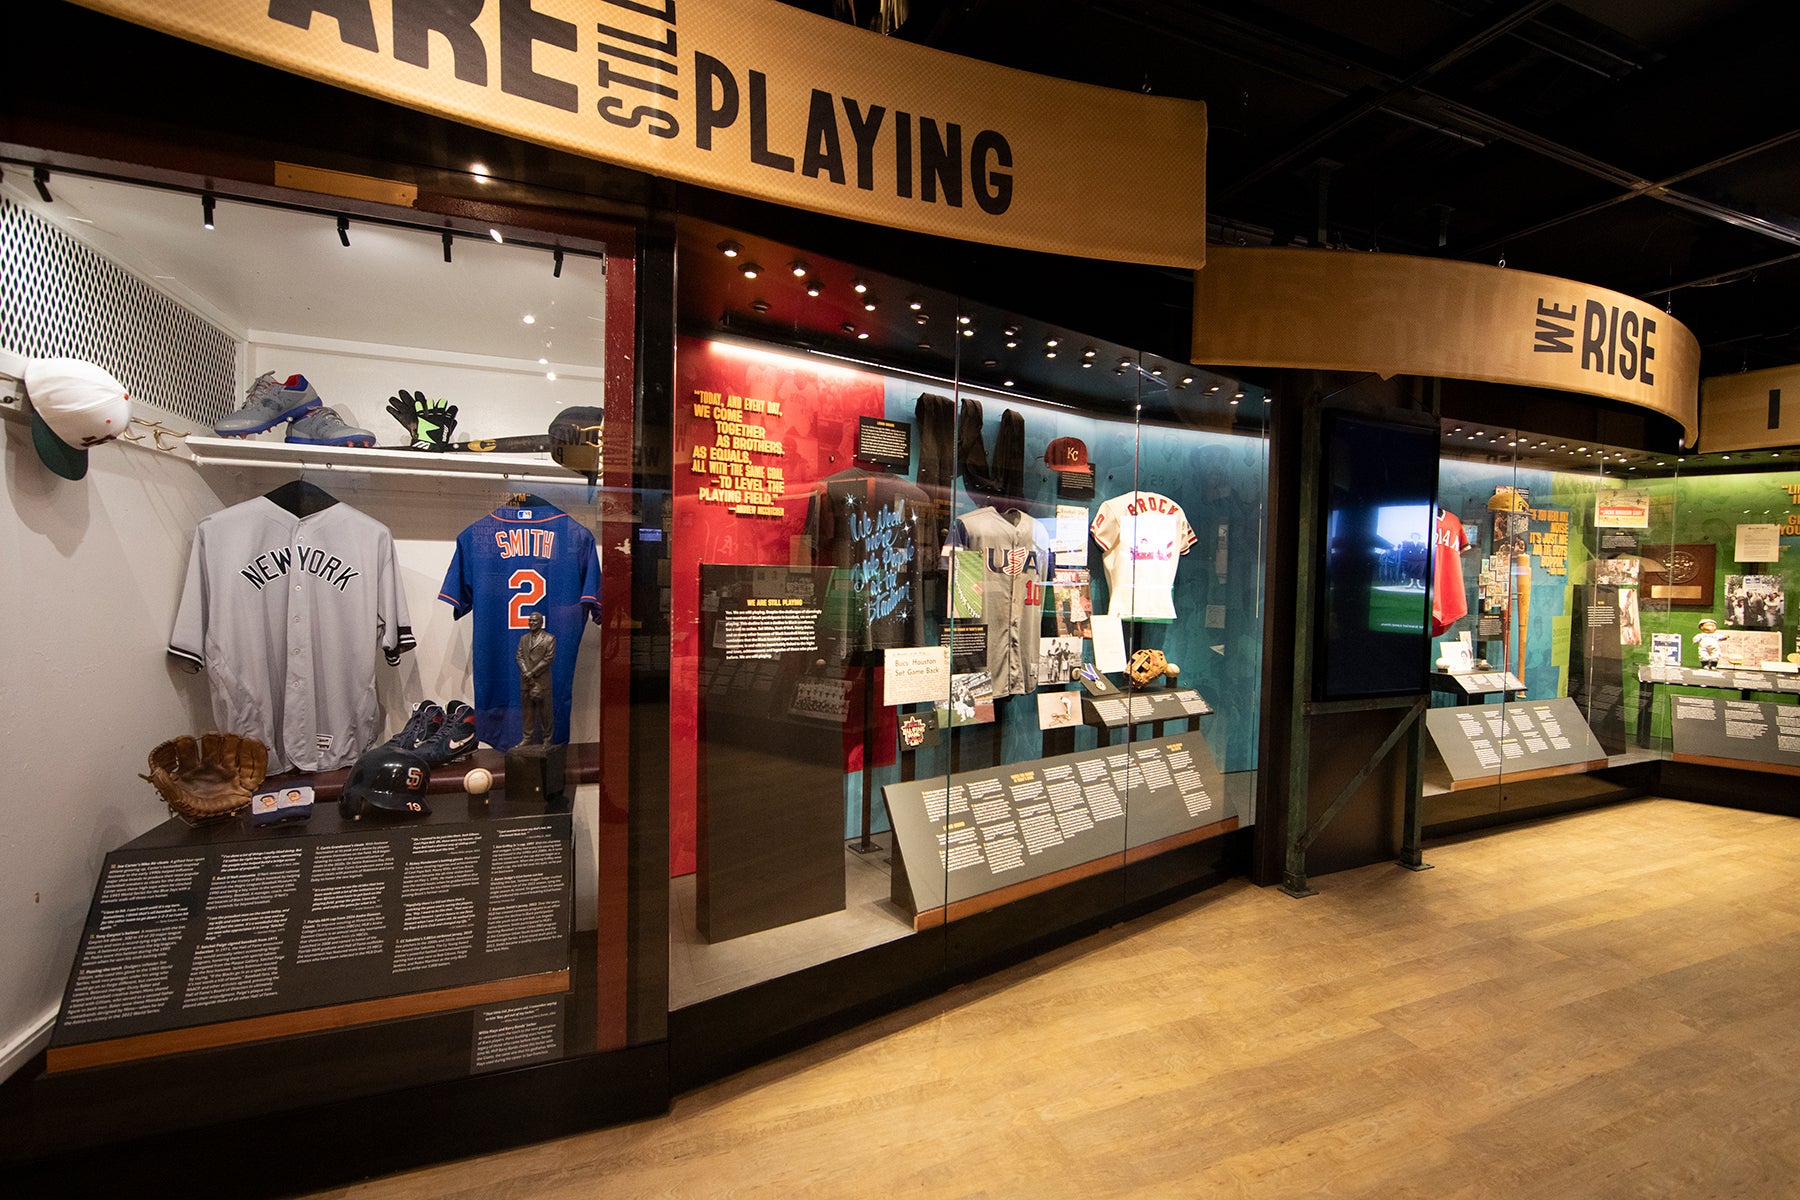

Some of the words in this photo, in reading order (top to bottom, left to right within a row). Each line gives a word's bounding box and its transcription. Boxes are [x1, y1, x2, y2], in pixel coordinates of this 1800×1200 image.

[695, 50, 1013, 215] PLAYING
[1533, 297, 1577, 353] WE
[1581, 299, 1657, 386] RISE
[694, 404, 710, 418] WE
[713, 406, 742, 422] COME
[727, 395, 742, 409] AND
[744, 397, 764, 412] EVERY
[716, 421, 765, 439] TOGETHER
[716, 435, 730, 448] AS
[693, 446, 707, 459] AS
[1067, 447, 1079, 462] KC
[692, 460, 706, 472] ALL
[709, 460, 728, 475] WITH
[730, 462, 743, 476] THE
[746, 464, 764, 478] SAME
[735, 477, 764, 492] LEVEL
[768, 480, 784, 494] THE
[700, 488, 741, 503] PLAYING
[1128, 496, 1178, 516] BROCK
[850, 511, 873, 542] We
[876, 499, 904, 531] Need
[495, 528, 556, 560] SMITH
[866, 529, 898, 552] more
[882, 537, 915, 572] People
[986, 546, 1039, 576] USA
[240, 547, 294, 592] NEW
[296, 545, 360, 592] YORK
[507, 568, 548, 630] 2
[782, 598, 803, 606] PLAYING
[1025, 580, 1041, 606] 10
[907, 668, 924, 676] Game
[405, 766, 424, 790] SD
[406, 800, 422, 812] 19
